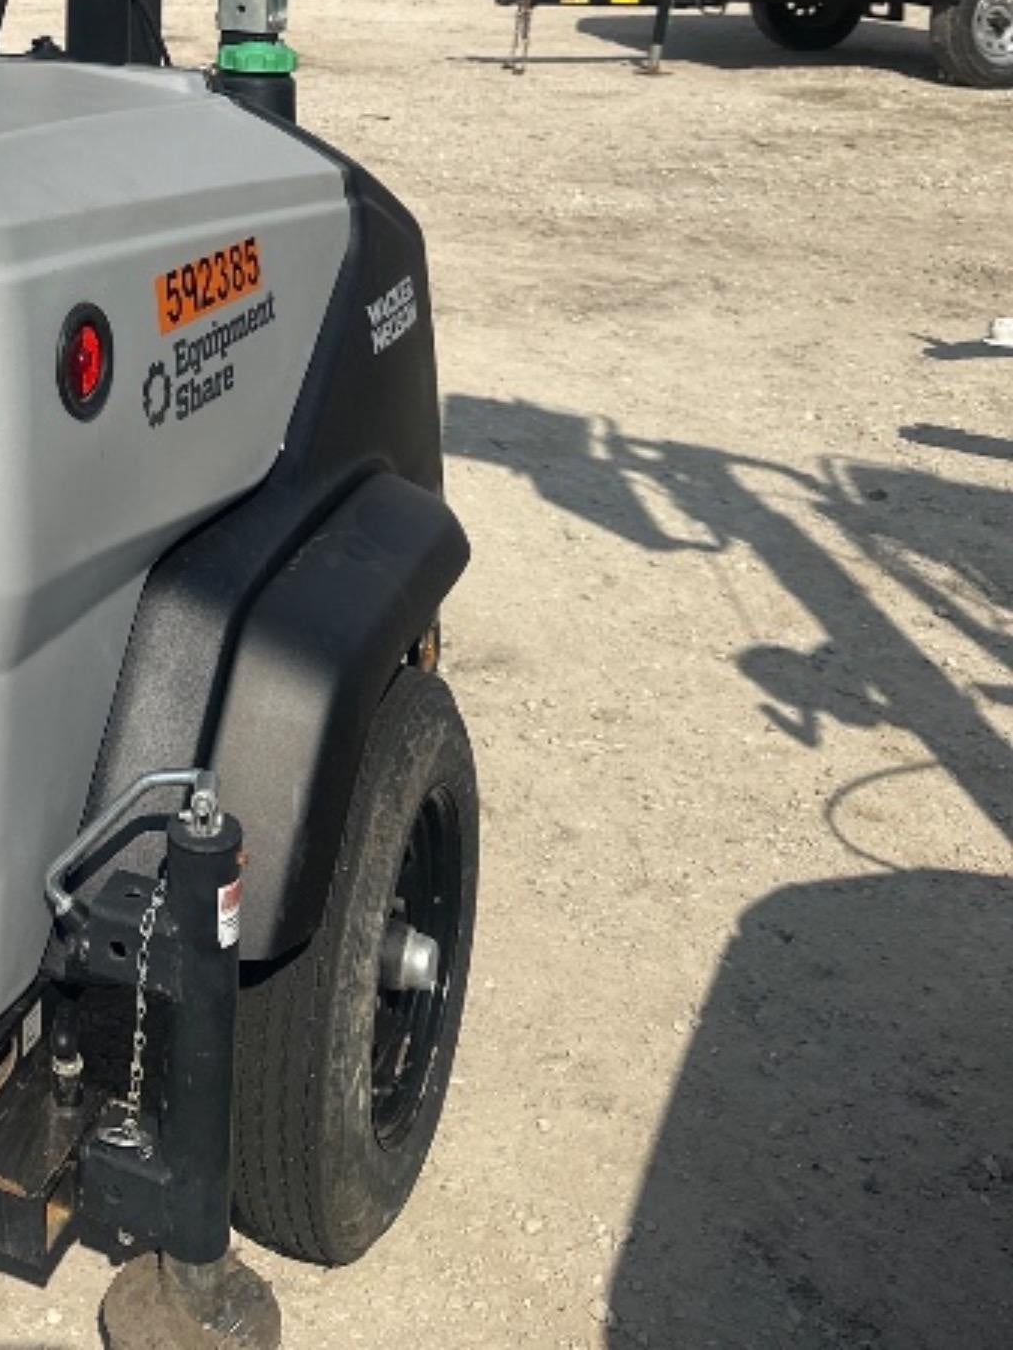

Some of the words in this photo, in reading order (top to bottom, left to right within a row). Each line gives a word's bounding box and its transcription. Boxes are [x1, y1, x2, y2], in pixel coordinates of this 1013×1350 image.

[165, 236, 262, 325] 592385
[173, 290, 276, 379] Equipment
[175, 363, 235, 422] Share
